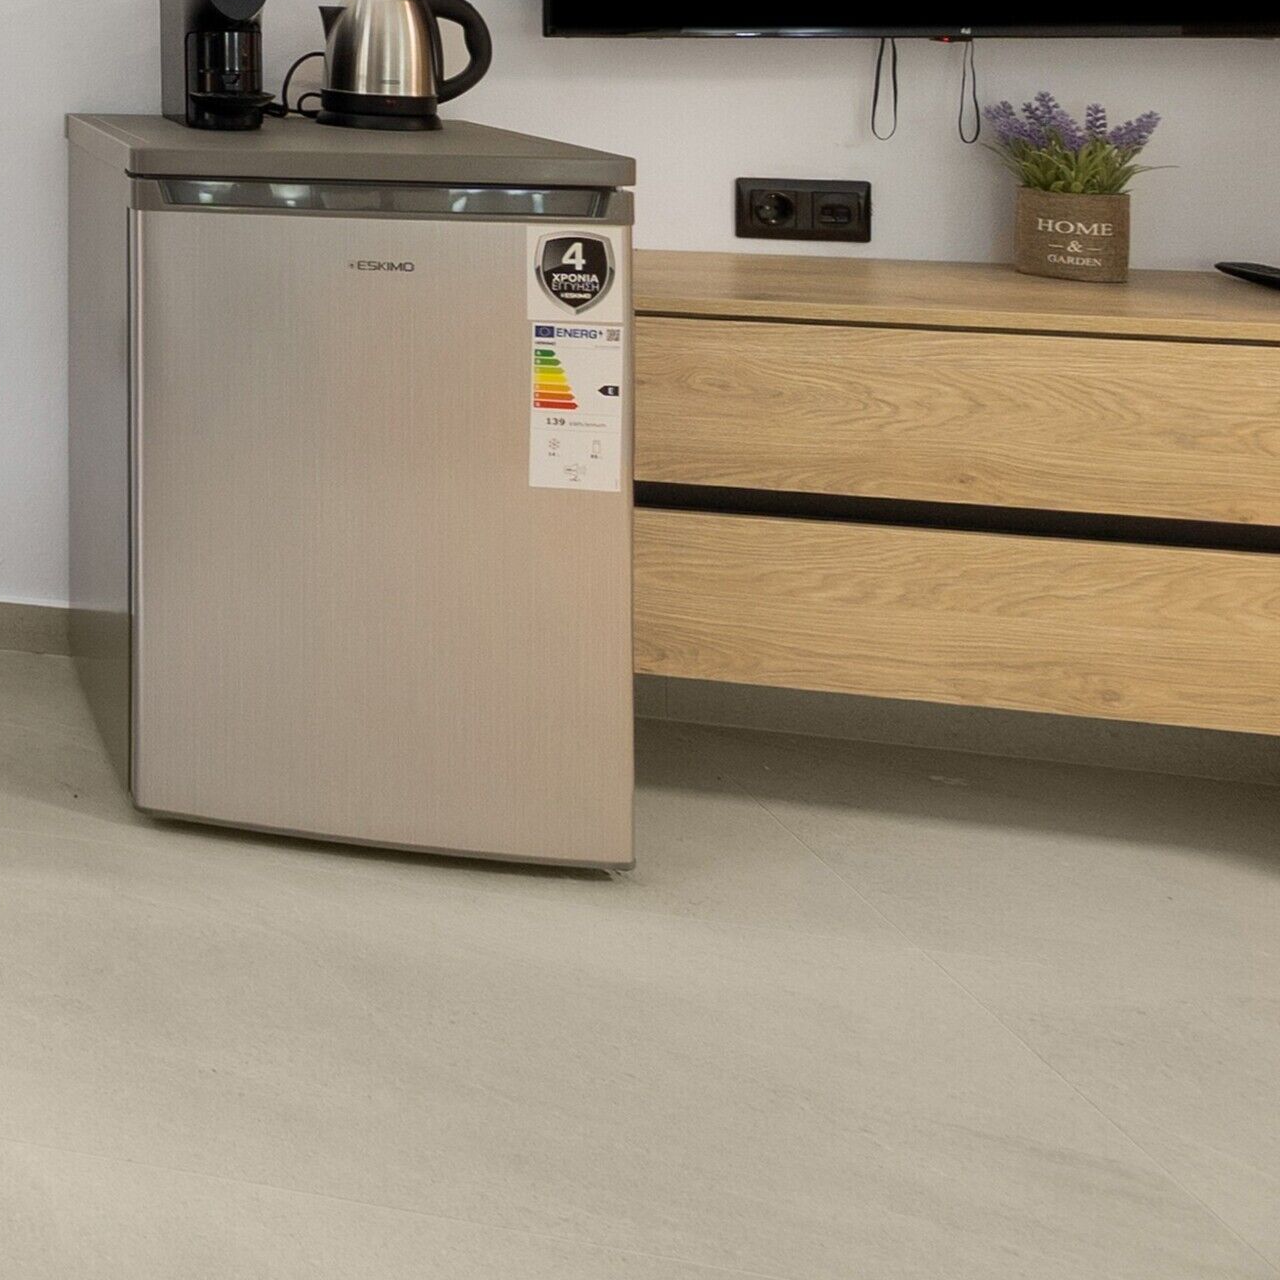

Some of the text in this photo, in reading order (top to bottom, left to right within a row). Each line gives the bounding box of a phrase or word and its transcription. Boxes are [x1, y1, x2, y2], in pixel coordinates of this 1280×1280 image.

[1037, 217, 1113, 237] HOME
[1067, 239, 1083, 253] &
[562, 242, 586, 271] 4
[1047, 254, 1103, 267] GARDEN
[357, 260, 415, 273] ESKIMO
[552, 273, 599, 283] ΧΡΟΝΙΑ
[556, 328, 598, 339] ENERG
[546, 417, 566, 426] 139
